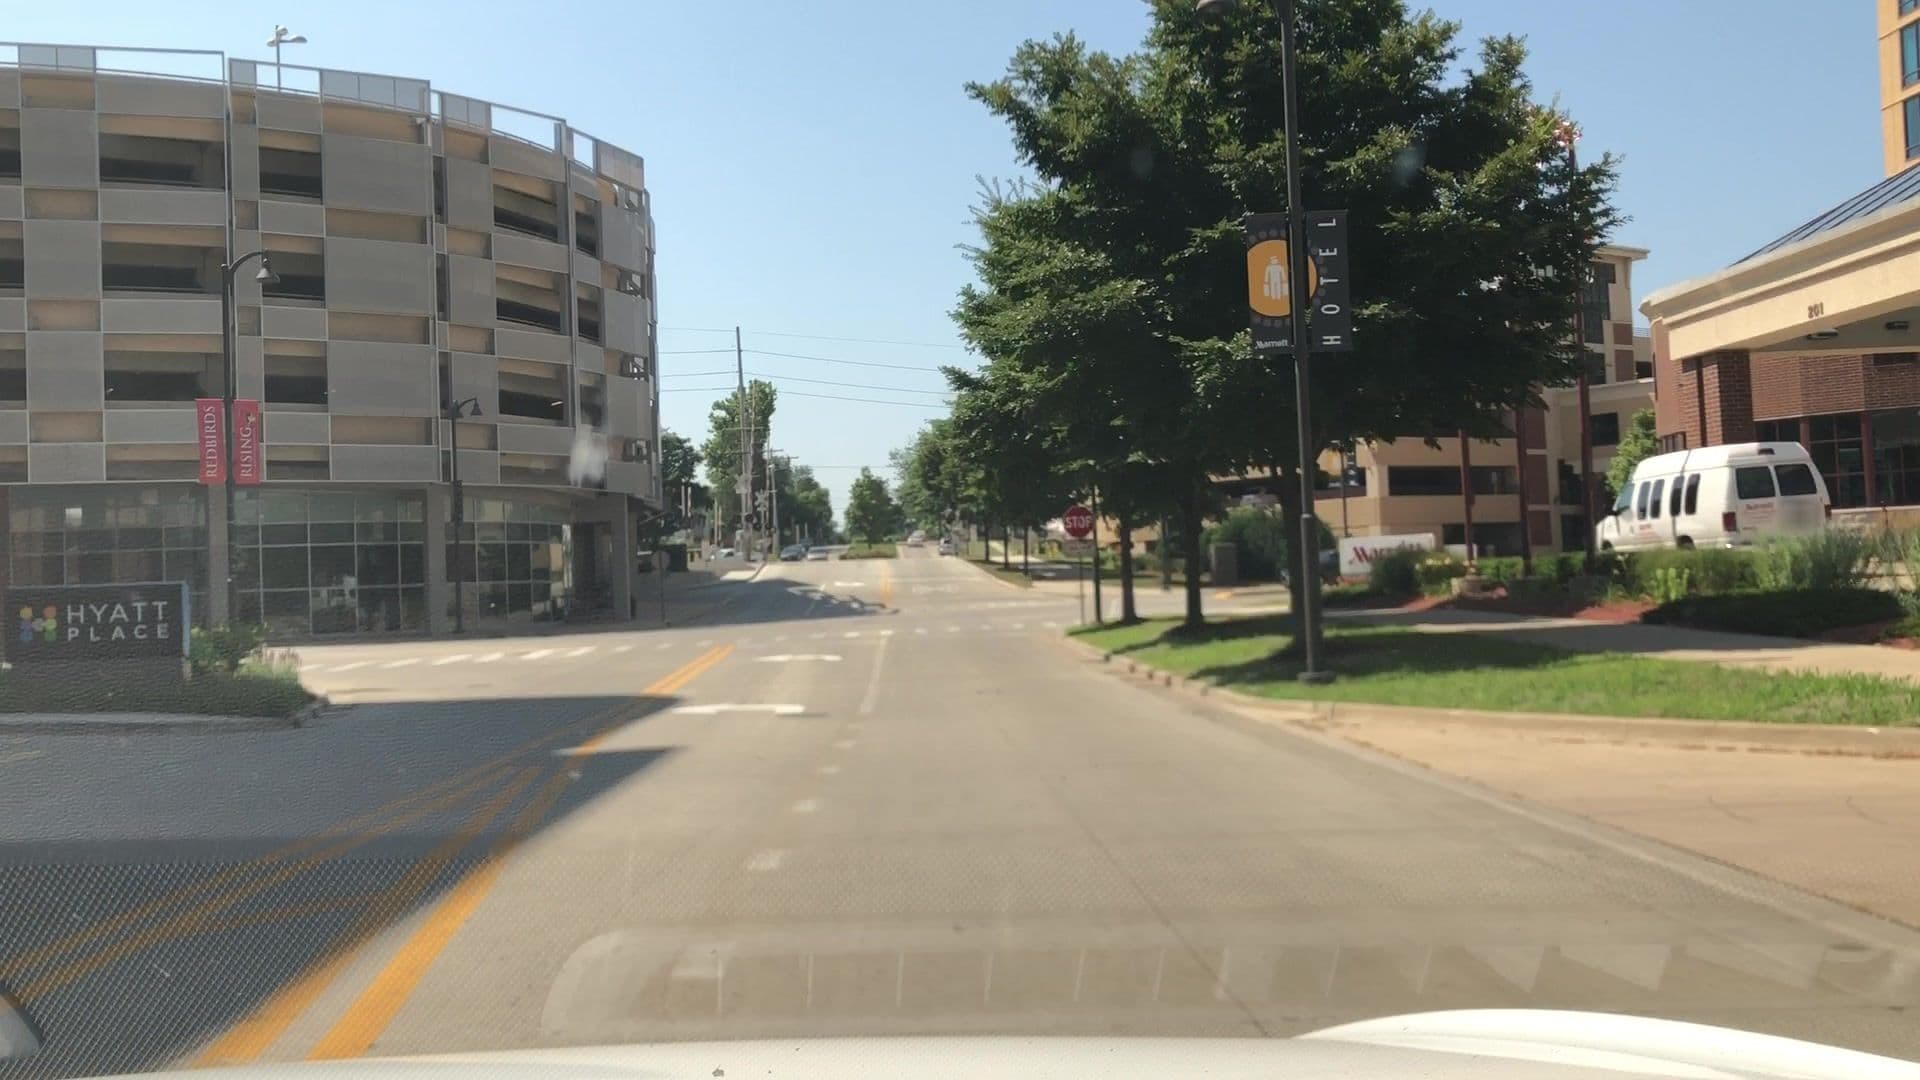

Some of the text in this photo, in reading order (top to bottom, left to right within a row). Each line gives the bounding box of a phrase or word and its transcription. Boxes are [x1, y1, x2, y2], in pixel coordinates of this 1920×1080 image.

[1317, 218, 1342, 346] HOTEL
[1807, 301, 1824, 320] 201
[203, 406, 218, 477] REDBIRDS
[240, 426, 253, 477] RISING
[1065, 515, 1091, 529] STOP
[67, 601, 168, 624] HYATT
[67, 623, 170, 642] PLACE
